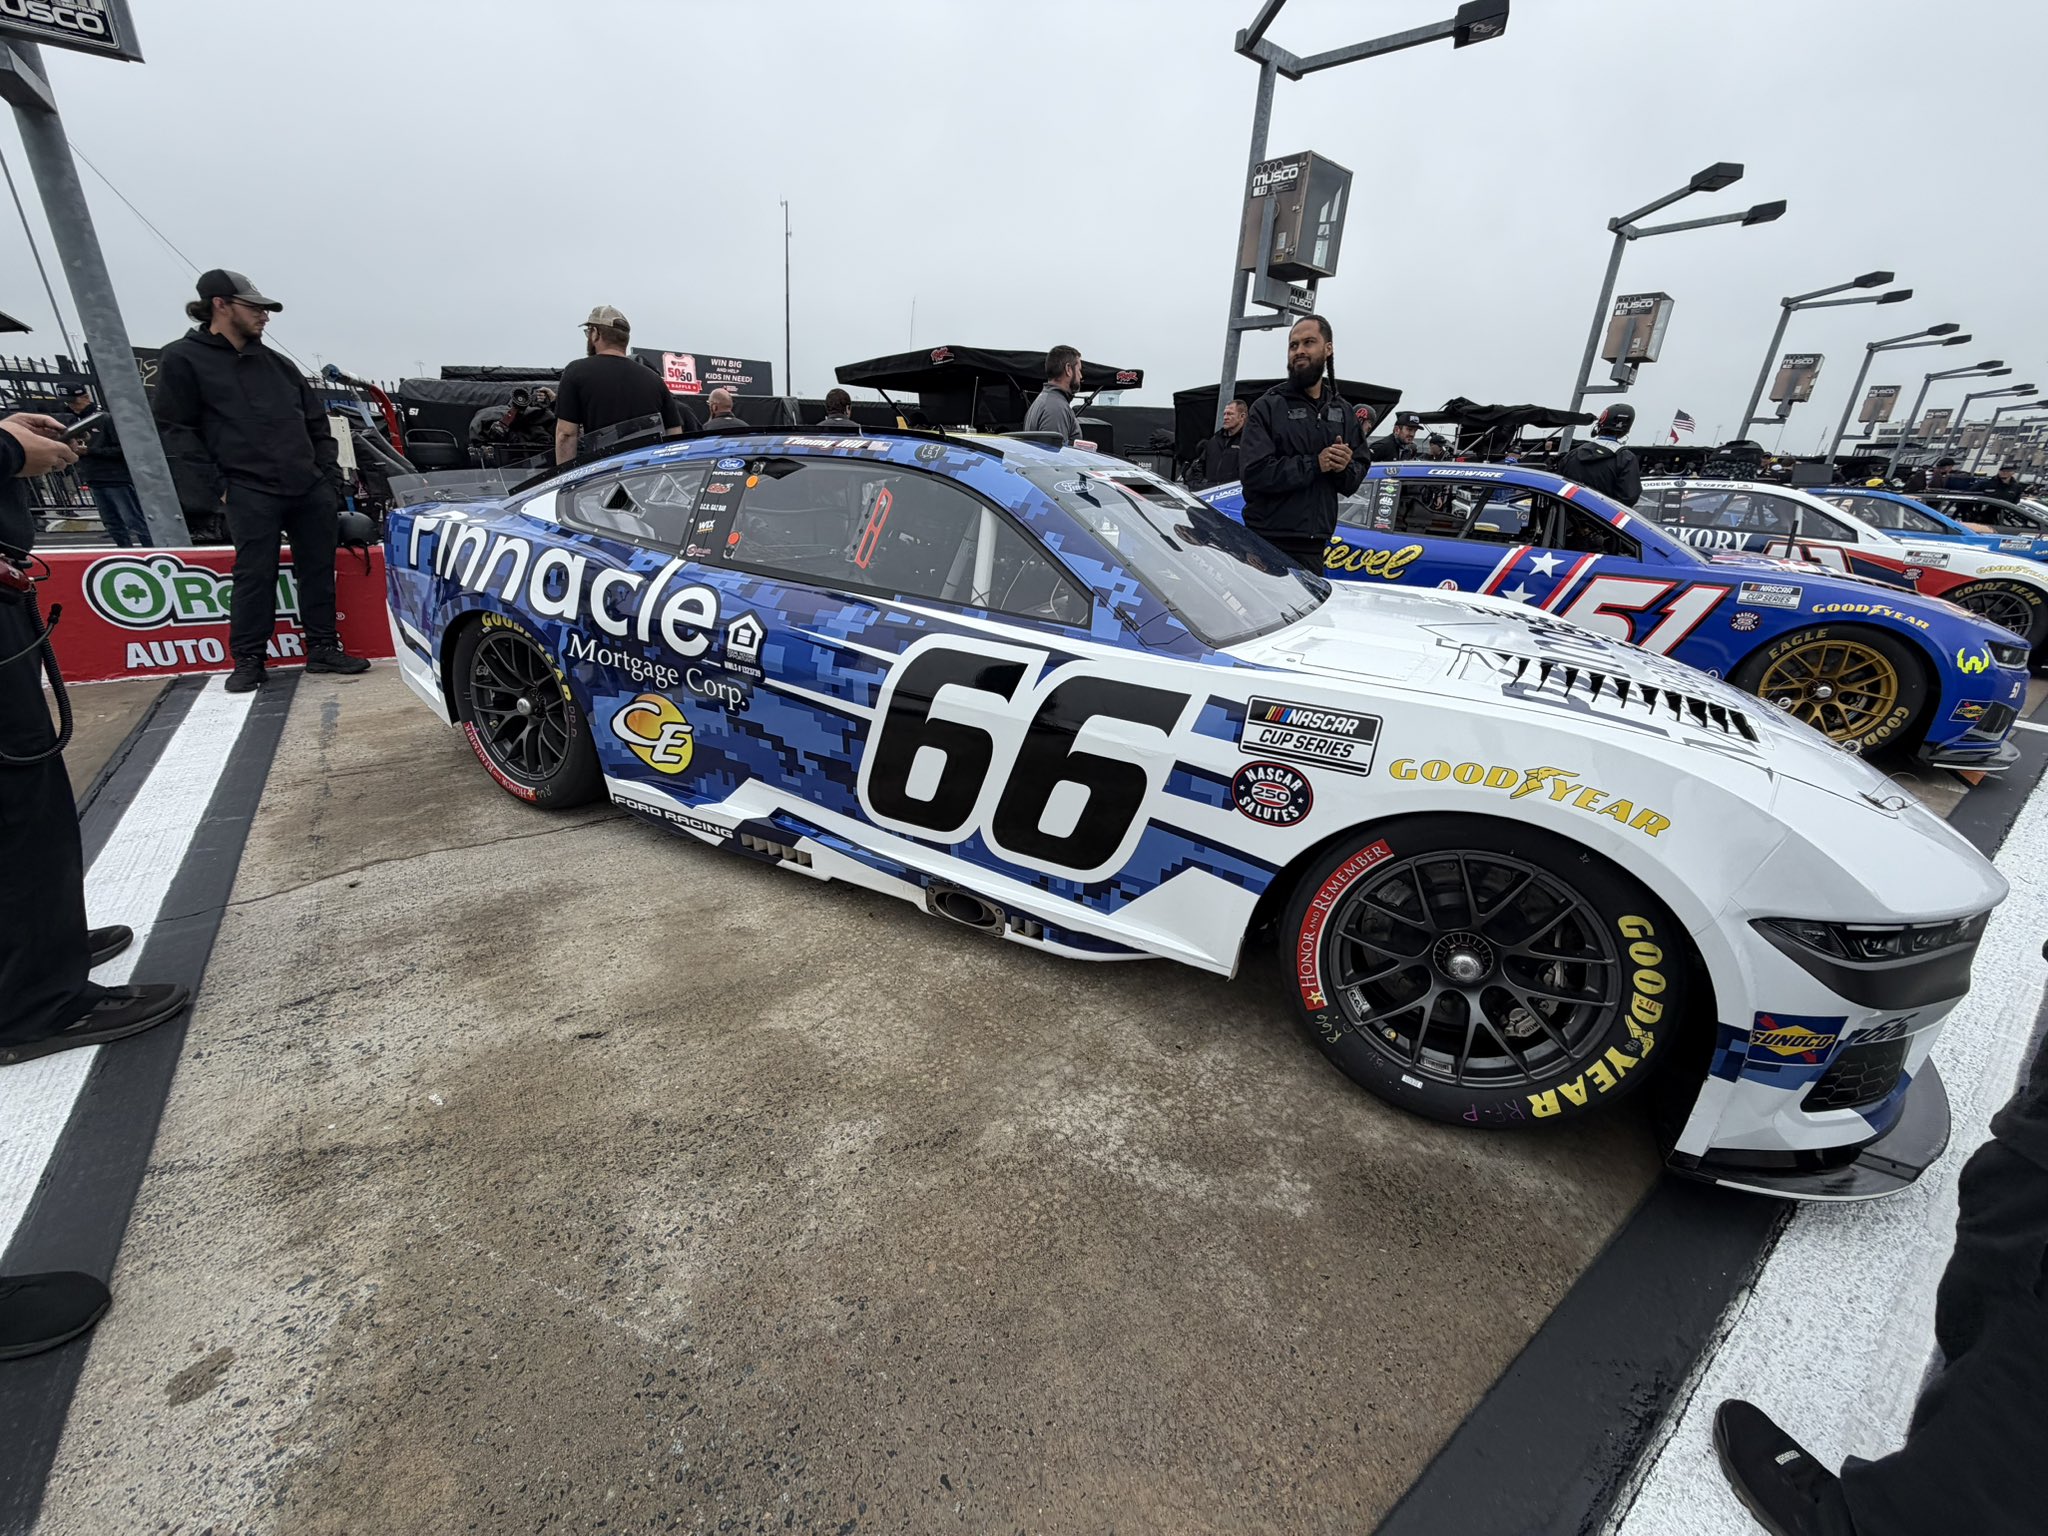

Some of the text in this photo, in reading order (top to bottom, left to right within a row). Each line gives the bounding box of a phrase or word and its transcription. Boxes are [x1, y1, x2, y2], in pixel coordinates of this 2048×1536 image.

[0, 0, 105, 35] USCO
[1253, 168, 1298, 187] MUSCO
[1289, 295, 1312, 309] MUSCO
[1616, 301, 1653, 310] MUSCO
[711, 358, 742, 369] WIN BIG
[705, 372, 753, 383] KIDS IN NEED!
[784, 436, 869, 449] Timmy Hill
[1464, 470, 1506, 478] WARE
[698, 520, 715, 530] WIX
[1759, 584, 1794, 594] NASCAR
[1763, 594, 1792, 604] SERIES
[1559, 575, 1732, 656] 51
[1812, 603, 1931, 630] GOODYEAR
[126, 637, 225, 669] AUTO
[1768, 627, 1831, 660] EAGLE
[567, 634, 747, 708] Mortgage Corp.
[1286, 708, 1360, 735] NASCAR
[1259, 729, 1355, 758] CUP SERIES
[868, 646, 1193, 872] 66
[501, 777, 528, 798] HONOR
[1244, 767, 1303, 792] NASCAR
[1253, 786, 1290, 803] 250
[1389, 758, 1671, 838] GOODYEAR
[612, 796, 734, 839] FORD RACING
[1239, 796, 1300, 822] SALUTES
[1300, 844, 1388, 989] HONOR AND REMEMBER
[1526, 914, 1667, 1118] GOODYEAR
[1751, 1030, 1836, 1049] SUNOCO
